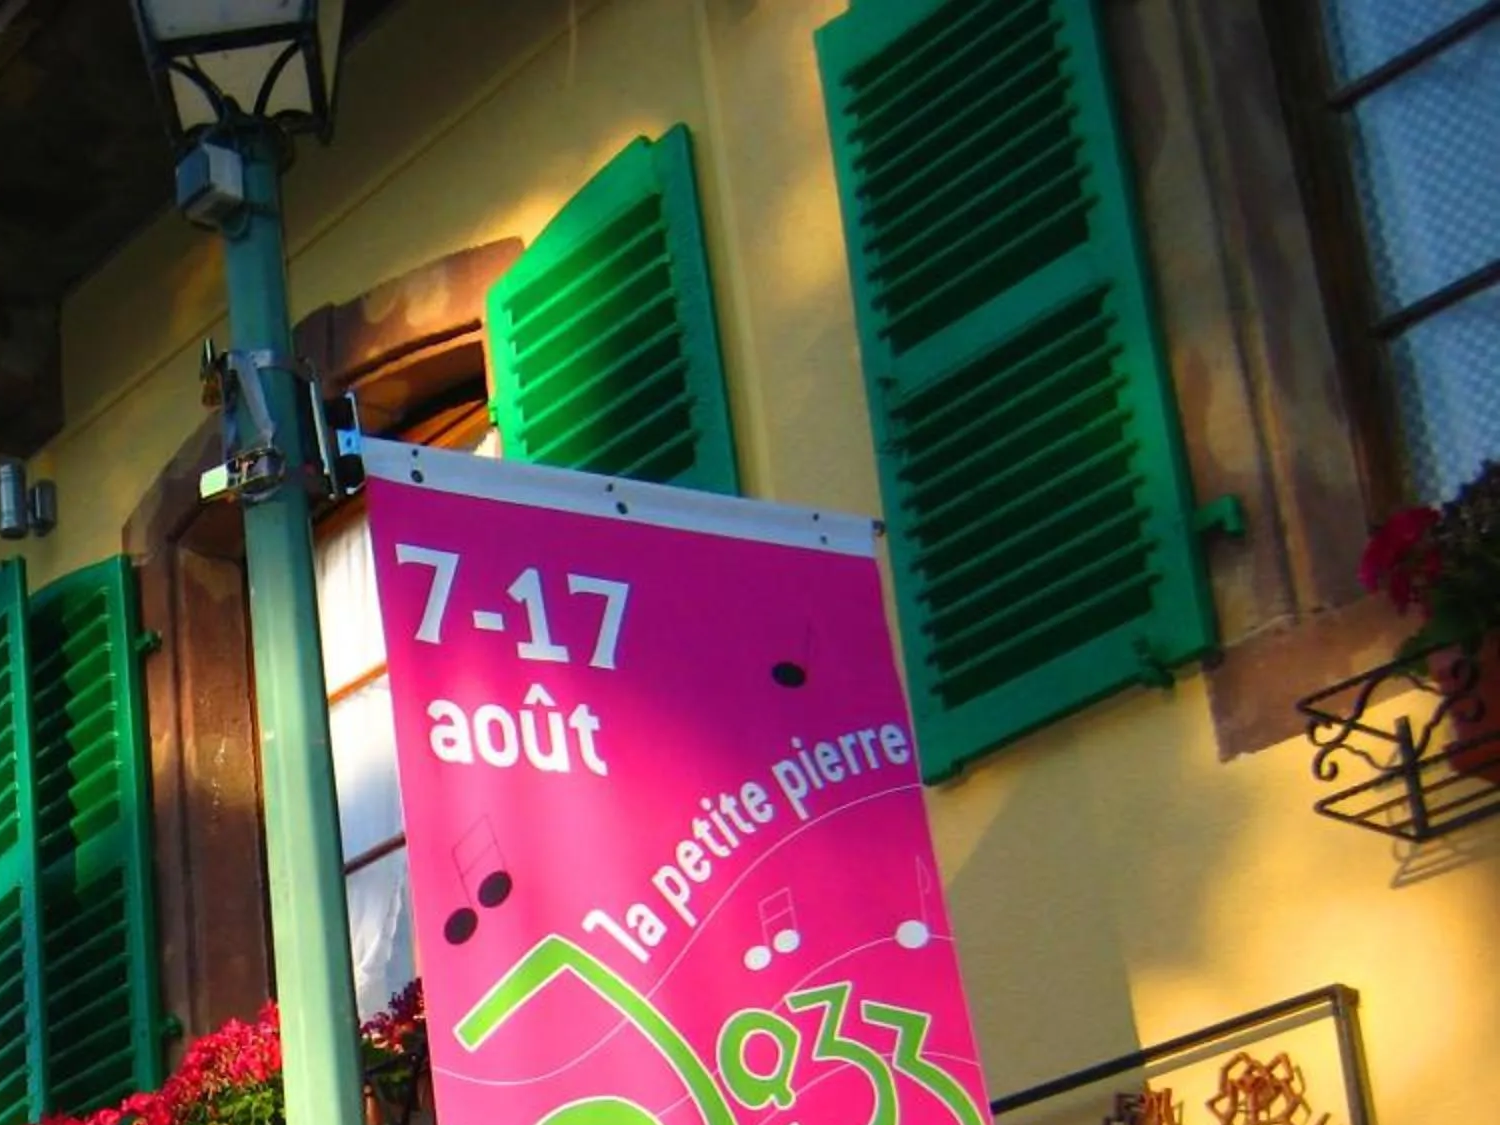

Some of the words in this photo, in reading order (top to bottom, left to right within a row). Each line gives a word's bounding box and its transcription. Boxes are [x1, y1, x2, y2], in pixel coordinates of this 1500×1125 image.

[394, 543, 630, 670] 7-17
[427, 684, 608, 776] août
[581, 908, 667, 964] la
[651, 781, 774, 928] petite
[771, 723, 911, 821] pierre
